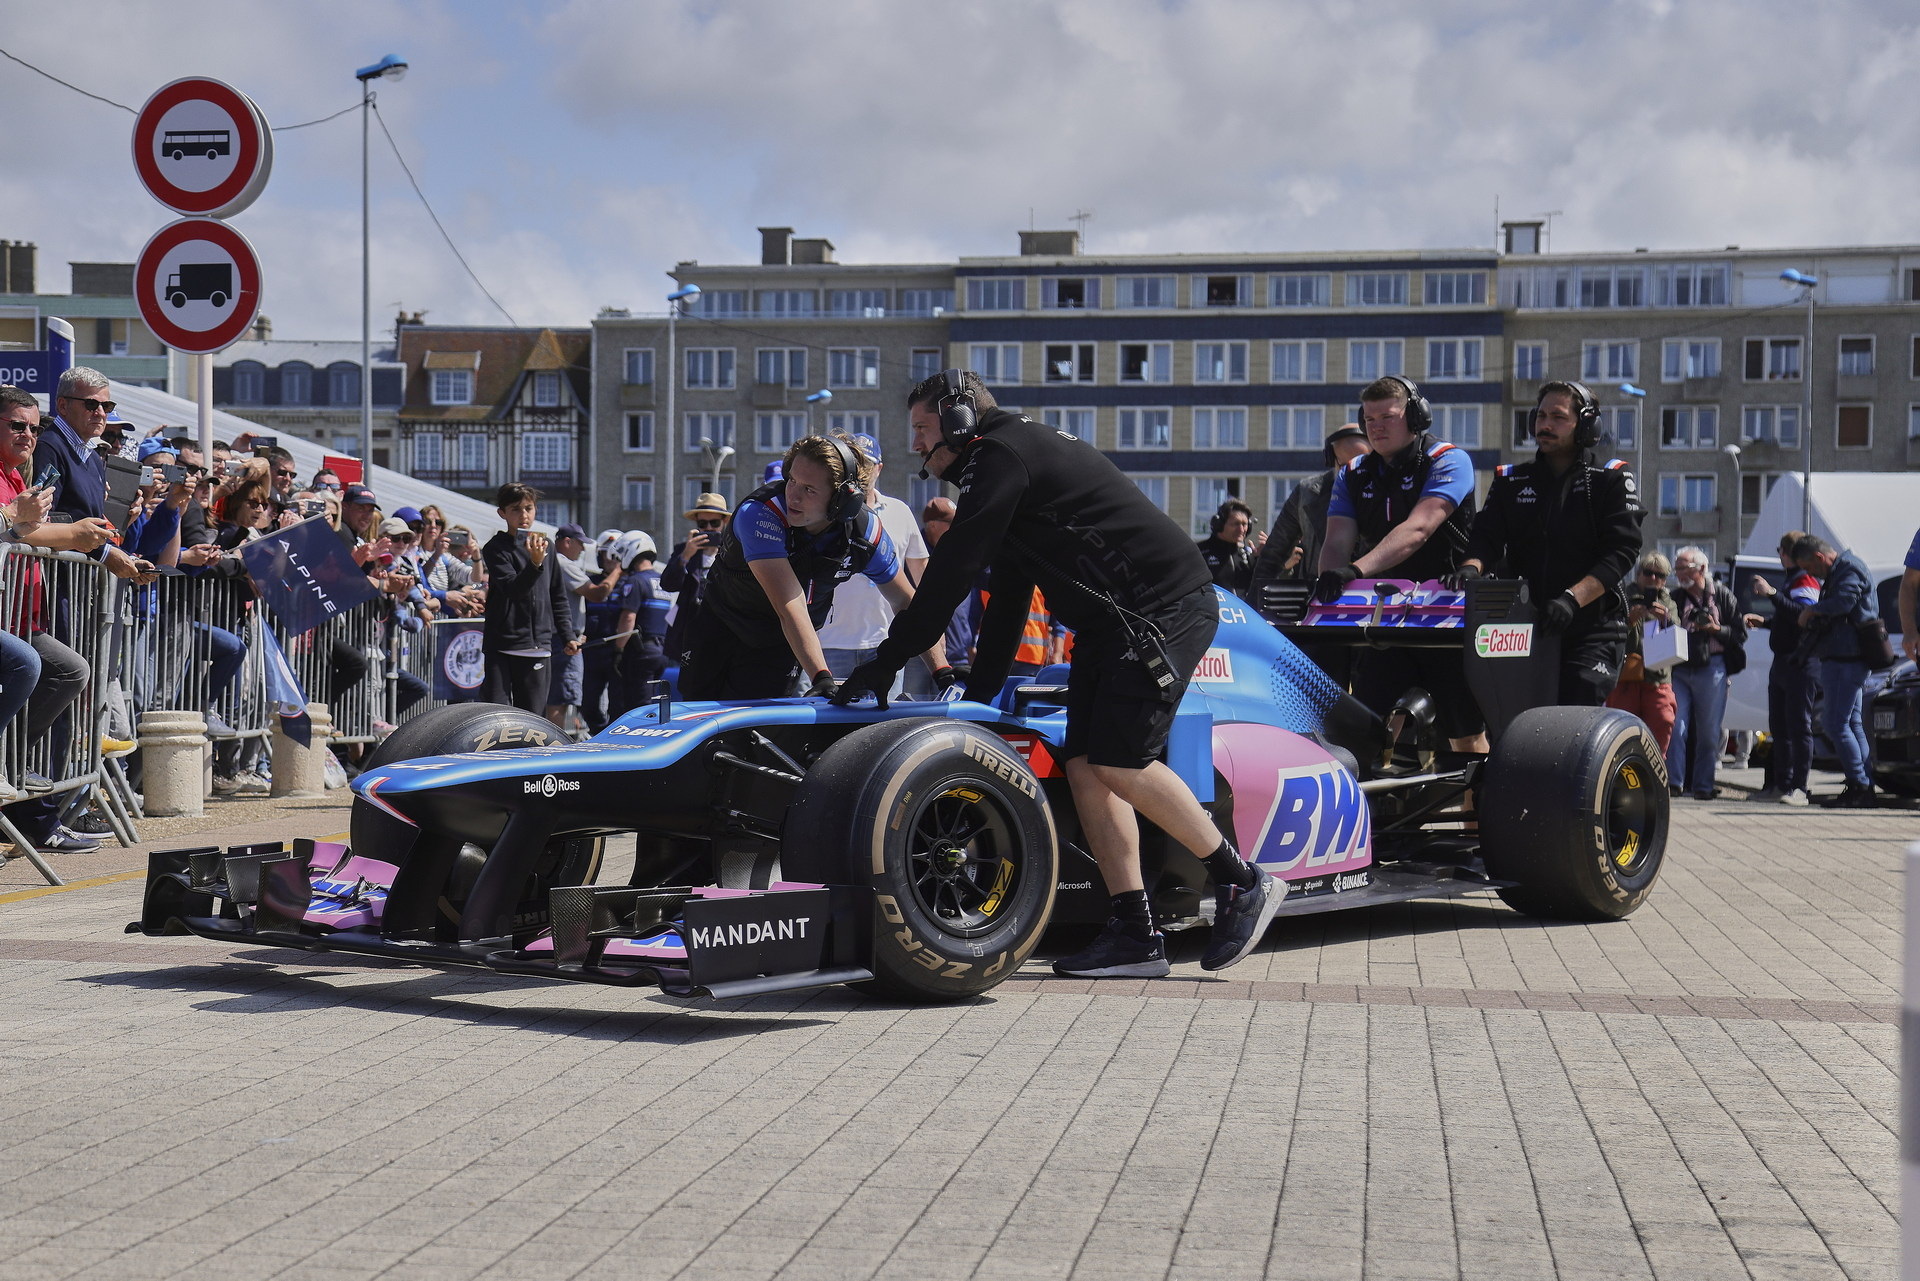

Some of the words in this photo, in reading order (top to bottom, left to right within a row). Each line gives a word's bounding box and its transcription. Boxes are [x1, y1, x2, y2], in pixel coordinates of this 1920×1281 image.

[279, 539, 337, 613] ALPINE
[1490, 629, 1529, 652] Castrol
[1192, 653, 1229, 678] strol
[626, 728, 682, 738] BWT
[964, 734, 1038, 800] PIRELLI
[1640, 728, 1668, 788] PIRELLI
[524, 781, 541, 793] Bell
[558, 779, 580, 791] Ross
[1594, 825, 1629, 903] ZERO
[691, 917, 810, 949] MANDANT
[877, 894, 973, 979] ZERO
[983, 950, 1007, 978] P
